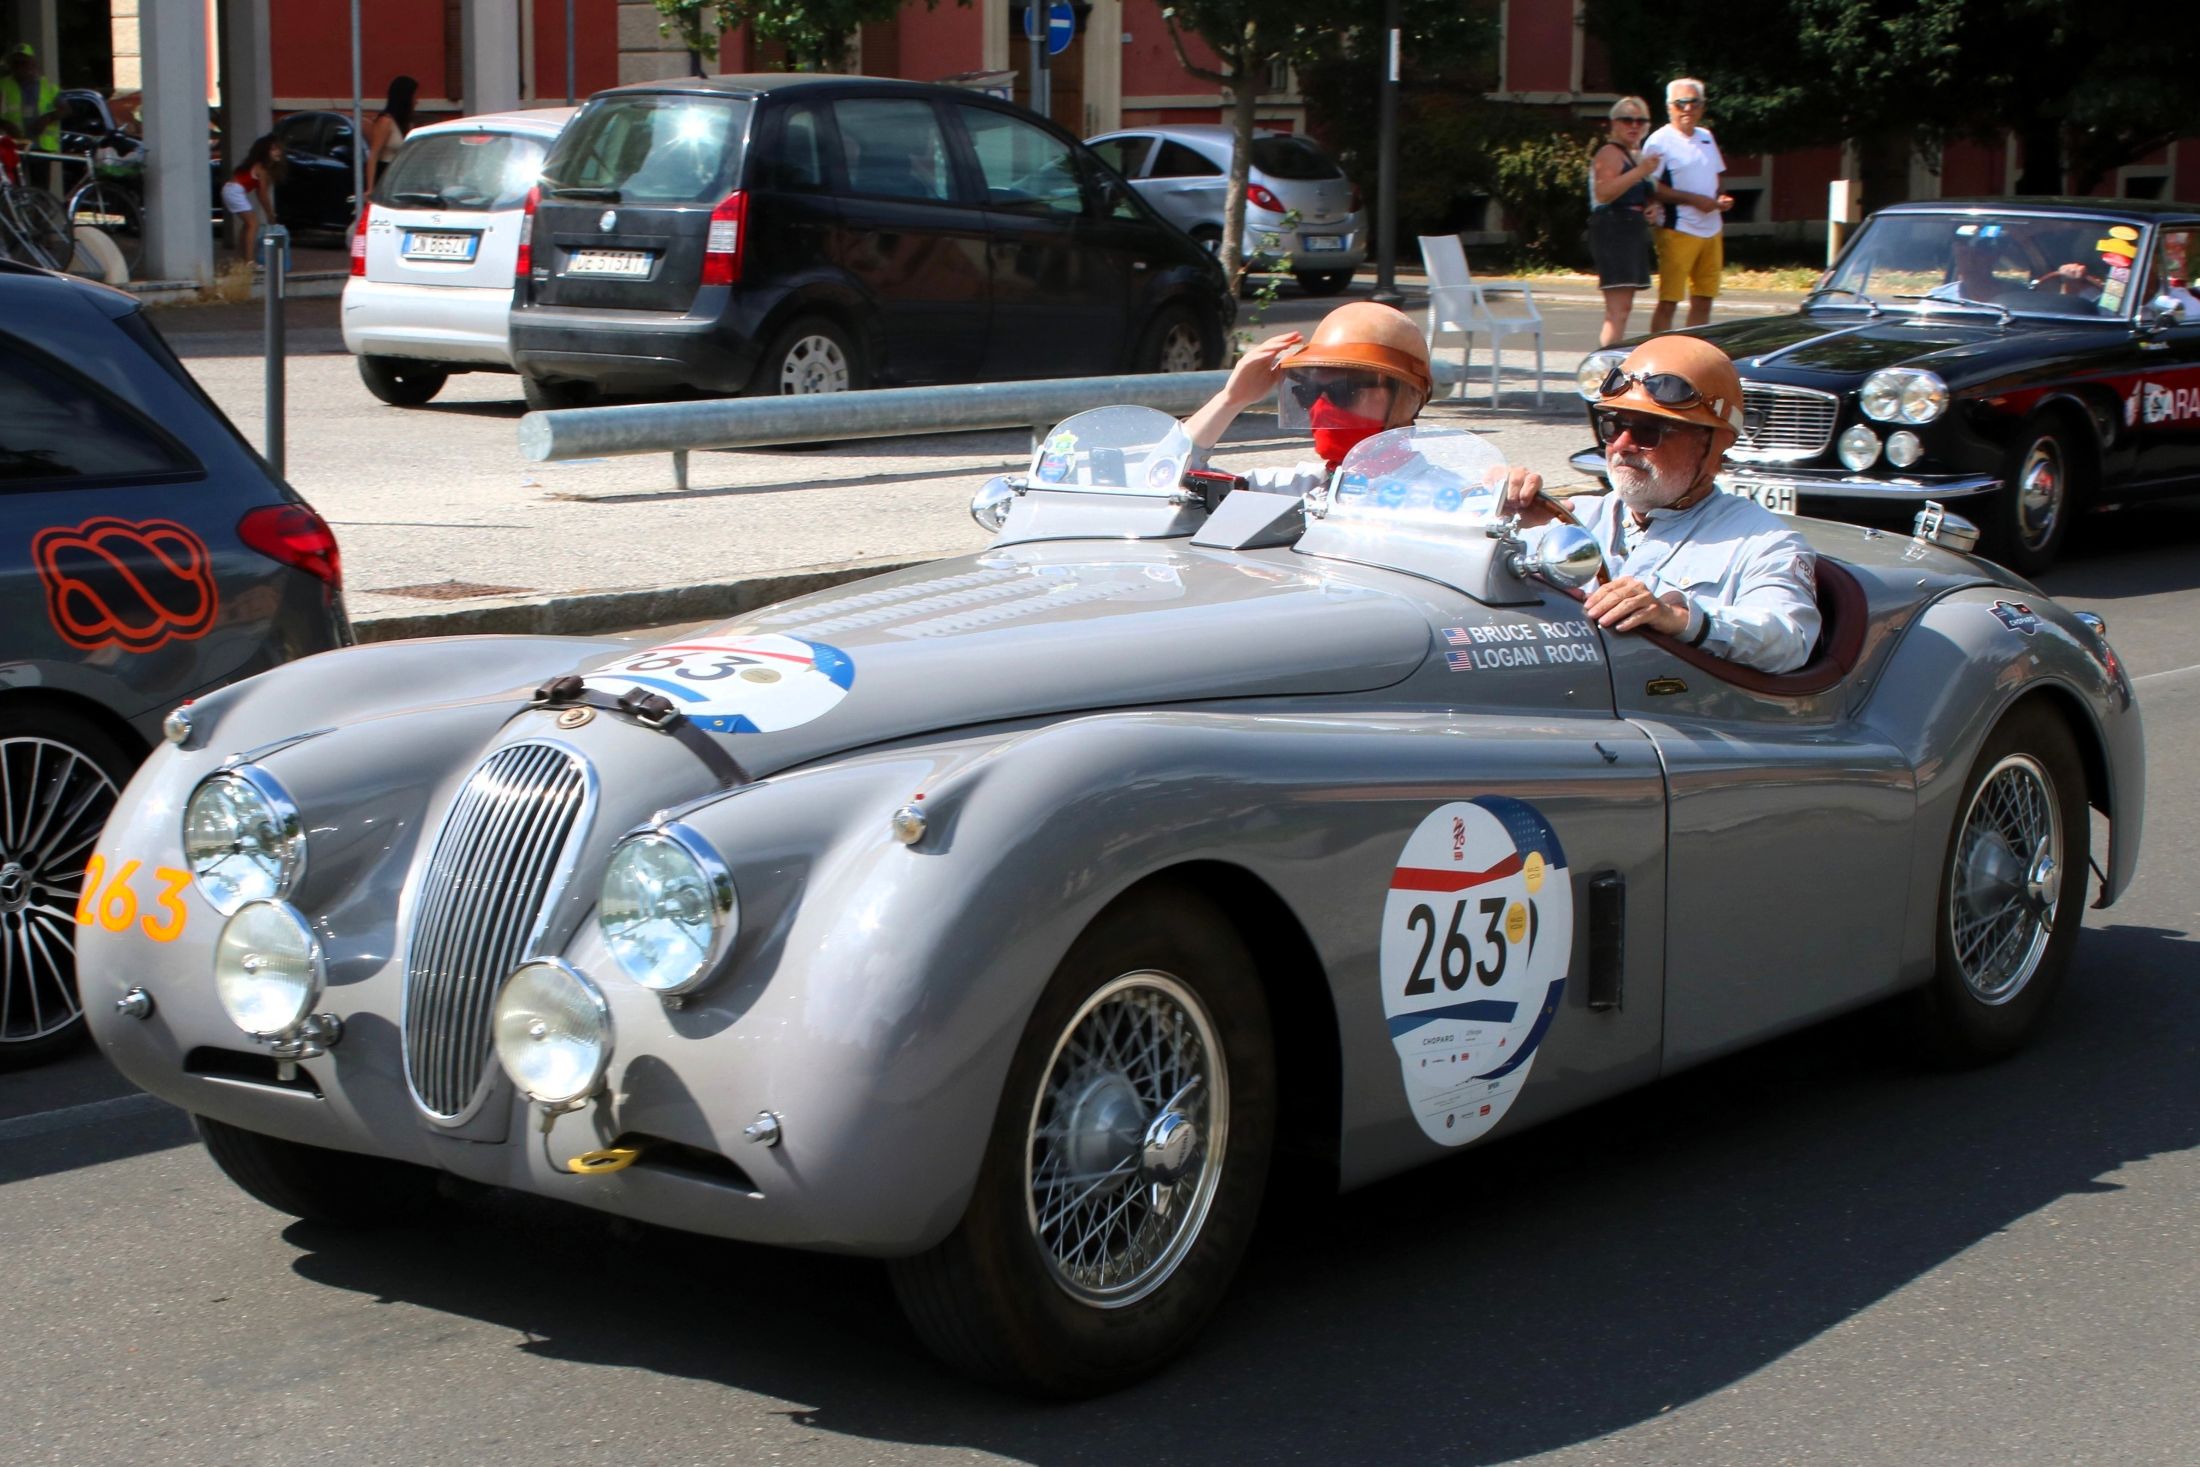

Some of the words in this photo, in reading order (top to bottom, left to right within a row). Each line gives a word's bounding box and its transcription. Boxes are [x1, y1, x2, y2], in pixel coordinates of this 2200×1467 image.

[1469, 624, 1537, 643] BRUCE
[1538, 621, 1594, 639] ROCH
[1473, 646, 1539, 668] LOGAN
[1544, 643, 1599, 663] ROCH
[75, 853, 194, 943] 263
[1404, 897, 1507, 997] 263
[1422, 1034, 1455, 1046] CHOPARD
